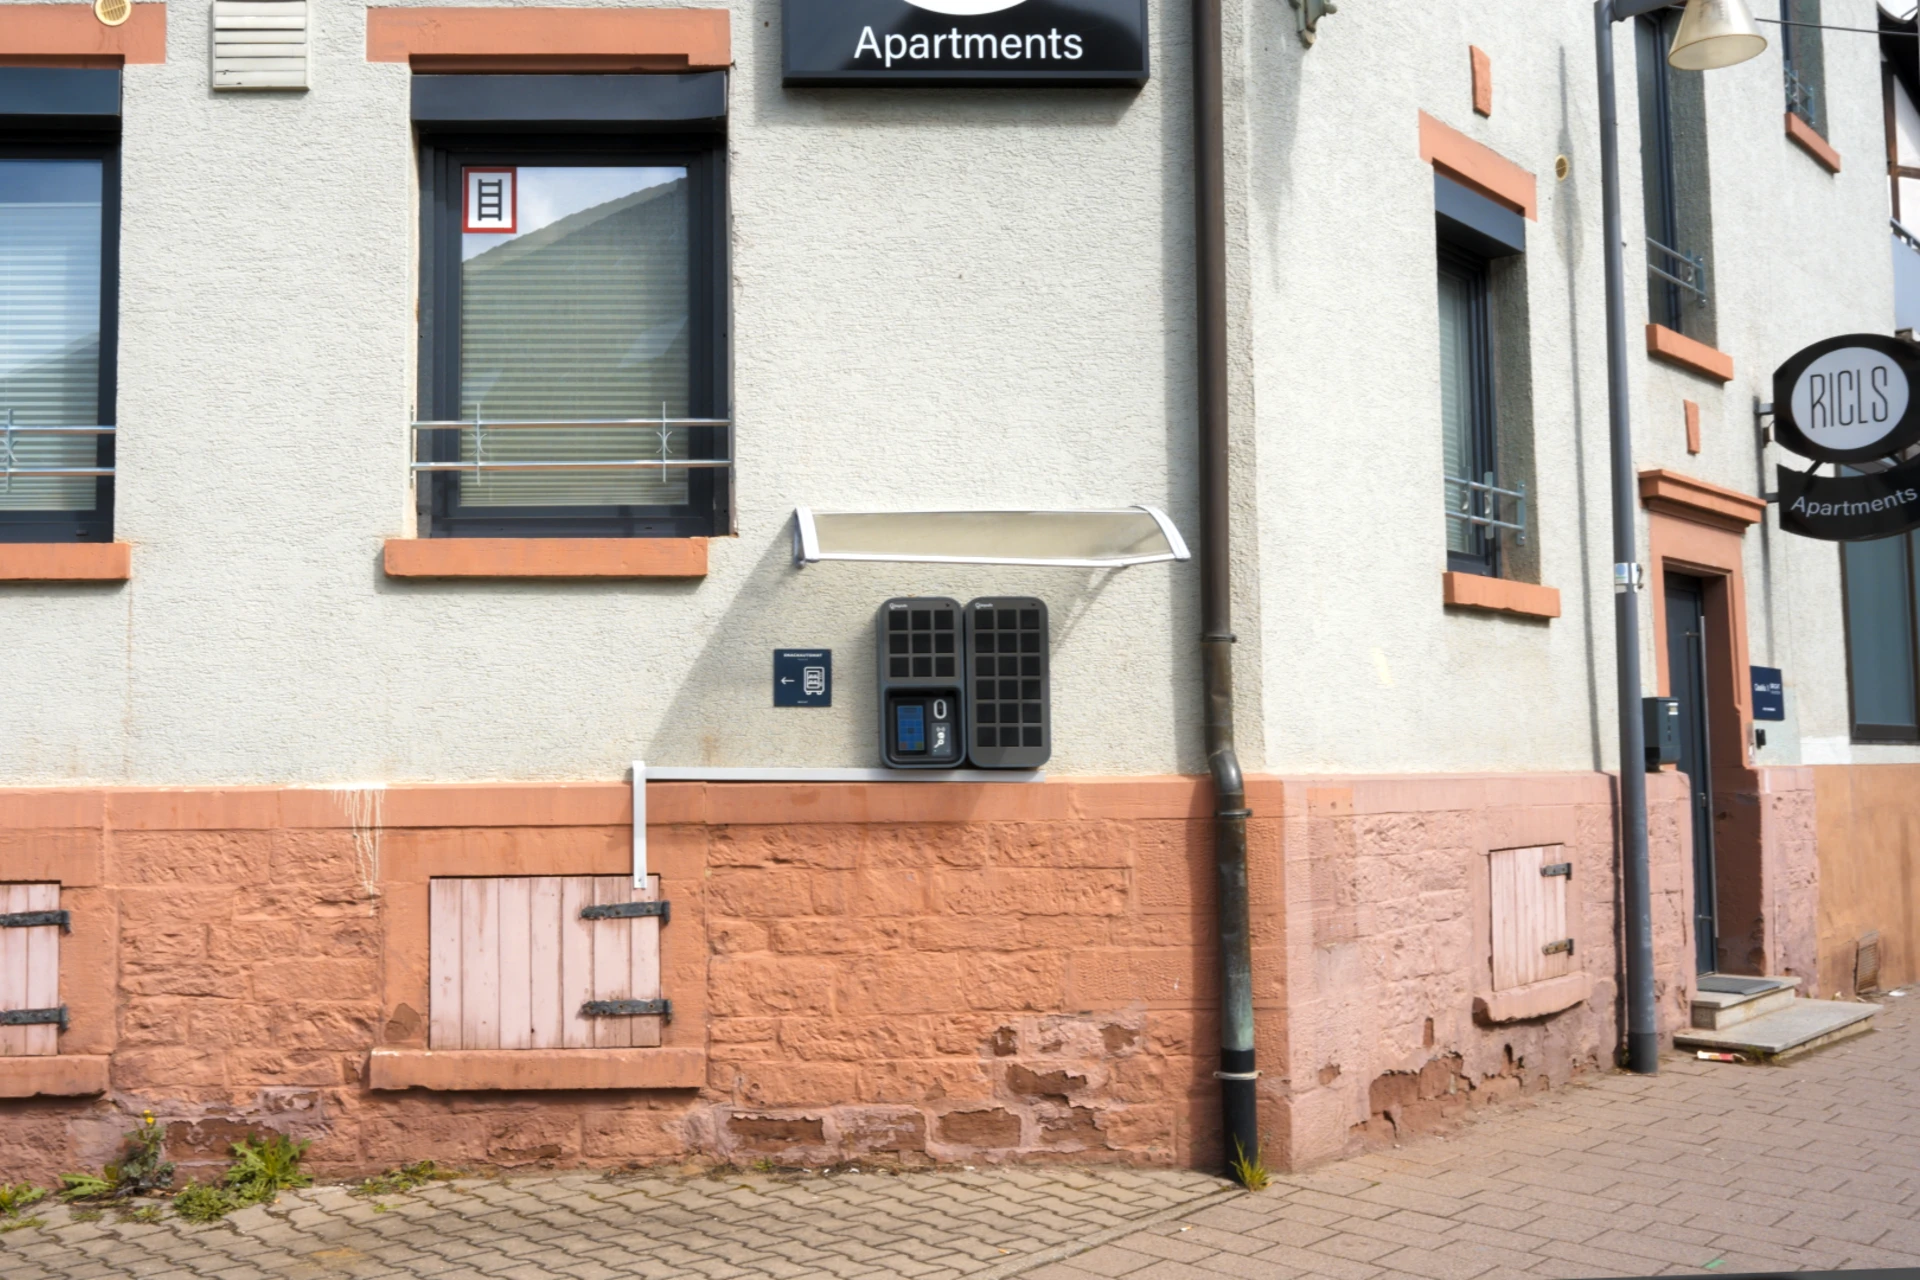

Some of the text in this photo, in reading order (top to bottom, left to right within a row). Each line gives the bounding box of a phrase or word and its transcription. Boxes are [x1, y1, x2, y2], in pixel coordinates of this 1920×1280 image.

[853, 26, 1084, 67] Apartments
[1809, 366, 1889, 430] RICLS
[1790, 487, 1918, 518] Apartments
